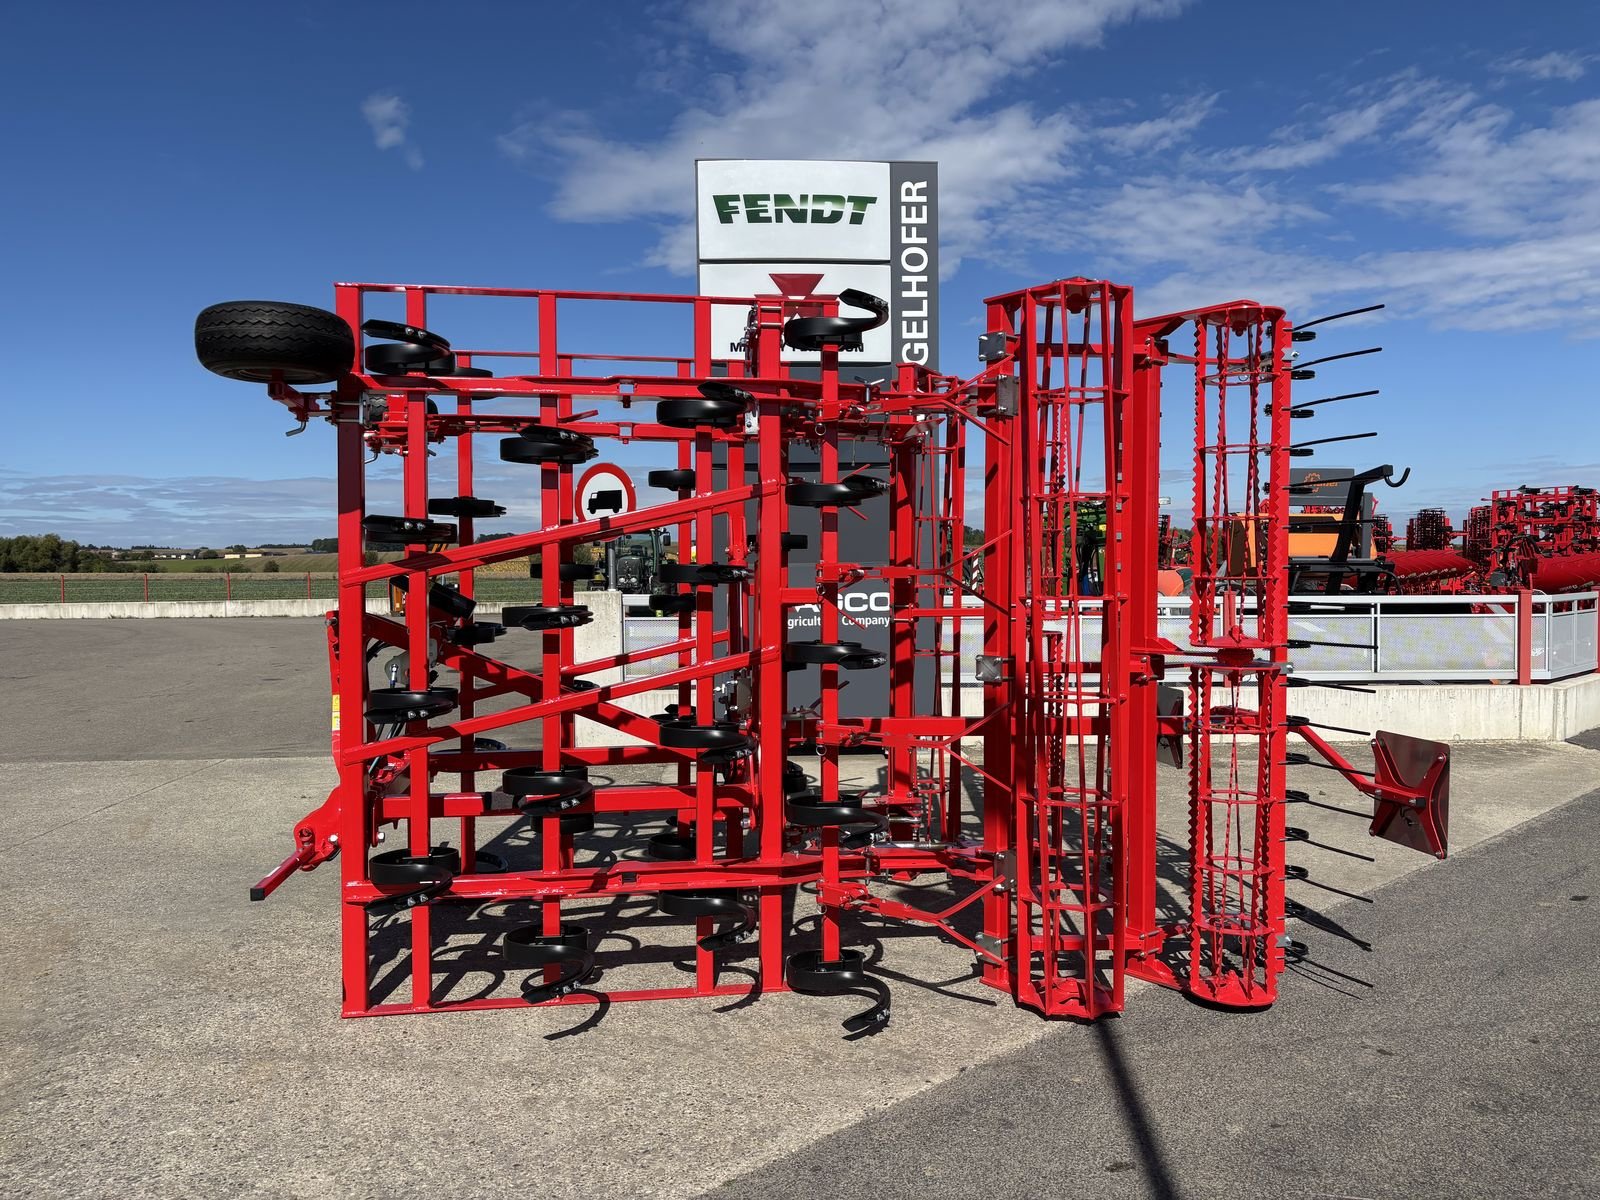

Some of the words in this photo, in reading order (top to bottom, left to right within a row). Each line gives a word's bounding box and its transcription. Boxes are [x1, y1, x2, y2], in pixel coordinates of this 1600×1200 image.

[712, 193, 878, 225] FENDT
[900, 180, 929, 367] GELHOFER
[787, 615, 821, 629] gricult
[841, 615, 890, 628] Company
